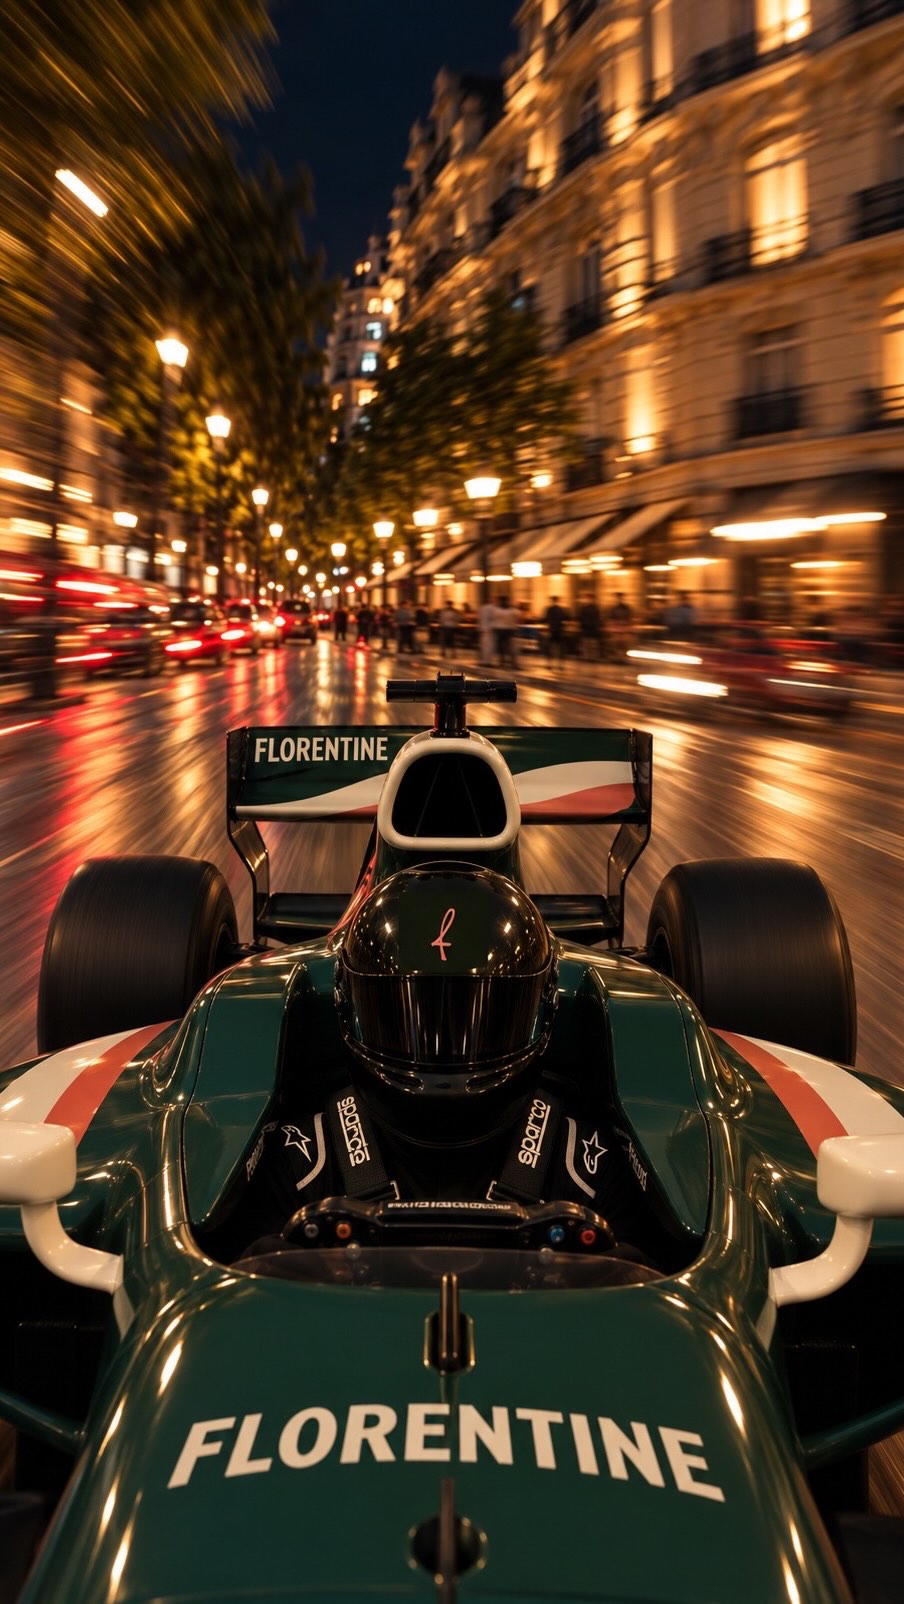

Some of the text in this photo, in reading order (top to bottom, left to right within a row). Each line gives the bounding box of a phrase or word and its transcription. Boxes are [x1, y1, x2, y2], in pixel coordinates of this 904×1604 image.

[254, 736, 389, 763] FLORENTINE
[518, 1099, 551, 1169] sparco
[167, 1403, 726, 1502] FLORENTINE
